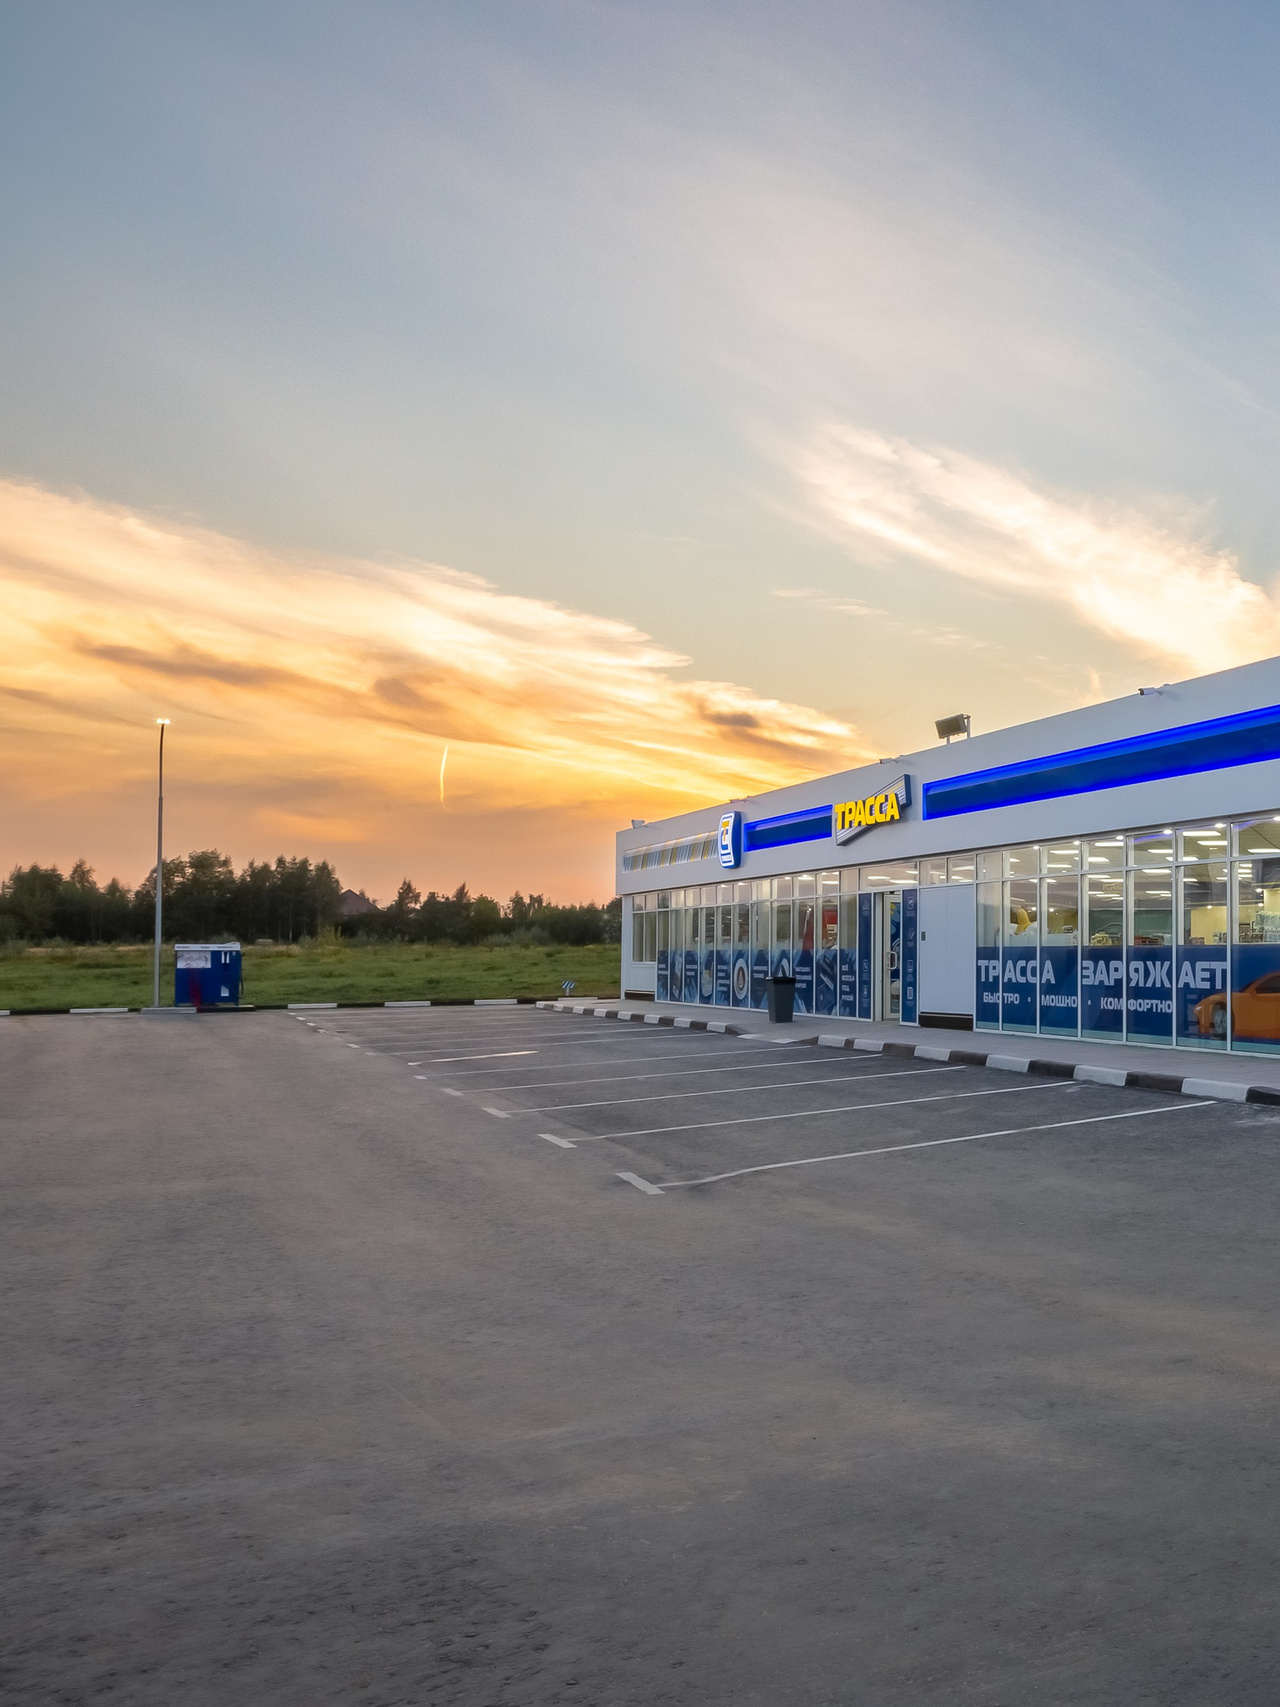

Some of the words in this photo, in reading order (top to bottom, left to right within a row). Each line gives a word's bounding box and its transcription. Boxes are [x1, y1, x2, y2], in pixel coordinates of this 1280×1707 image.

[834, 792, 900, 830] ТРАССА
[978, 960, 1056, 984] ТРАССА
[1082, 960, 1228, 990] ЗАРЯЖАЕТ
[983, 992, 1020, 1005] БЫСТРО
[1100, 997, 1173, 1014] КОМФОРТНО
